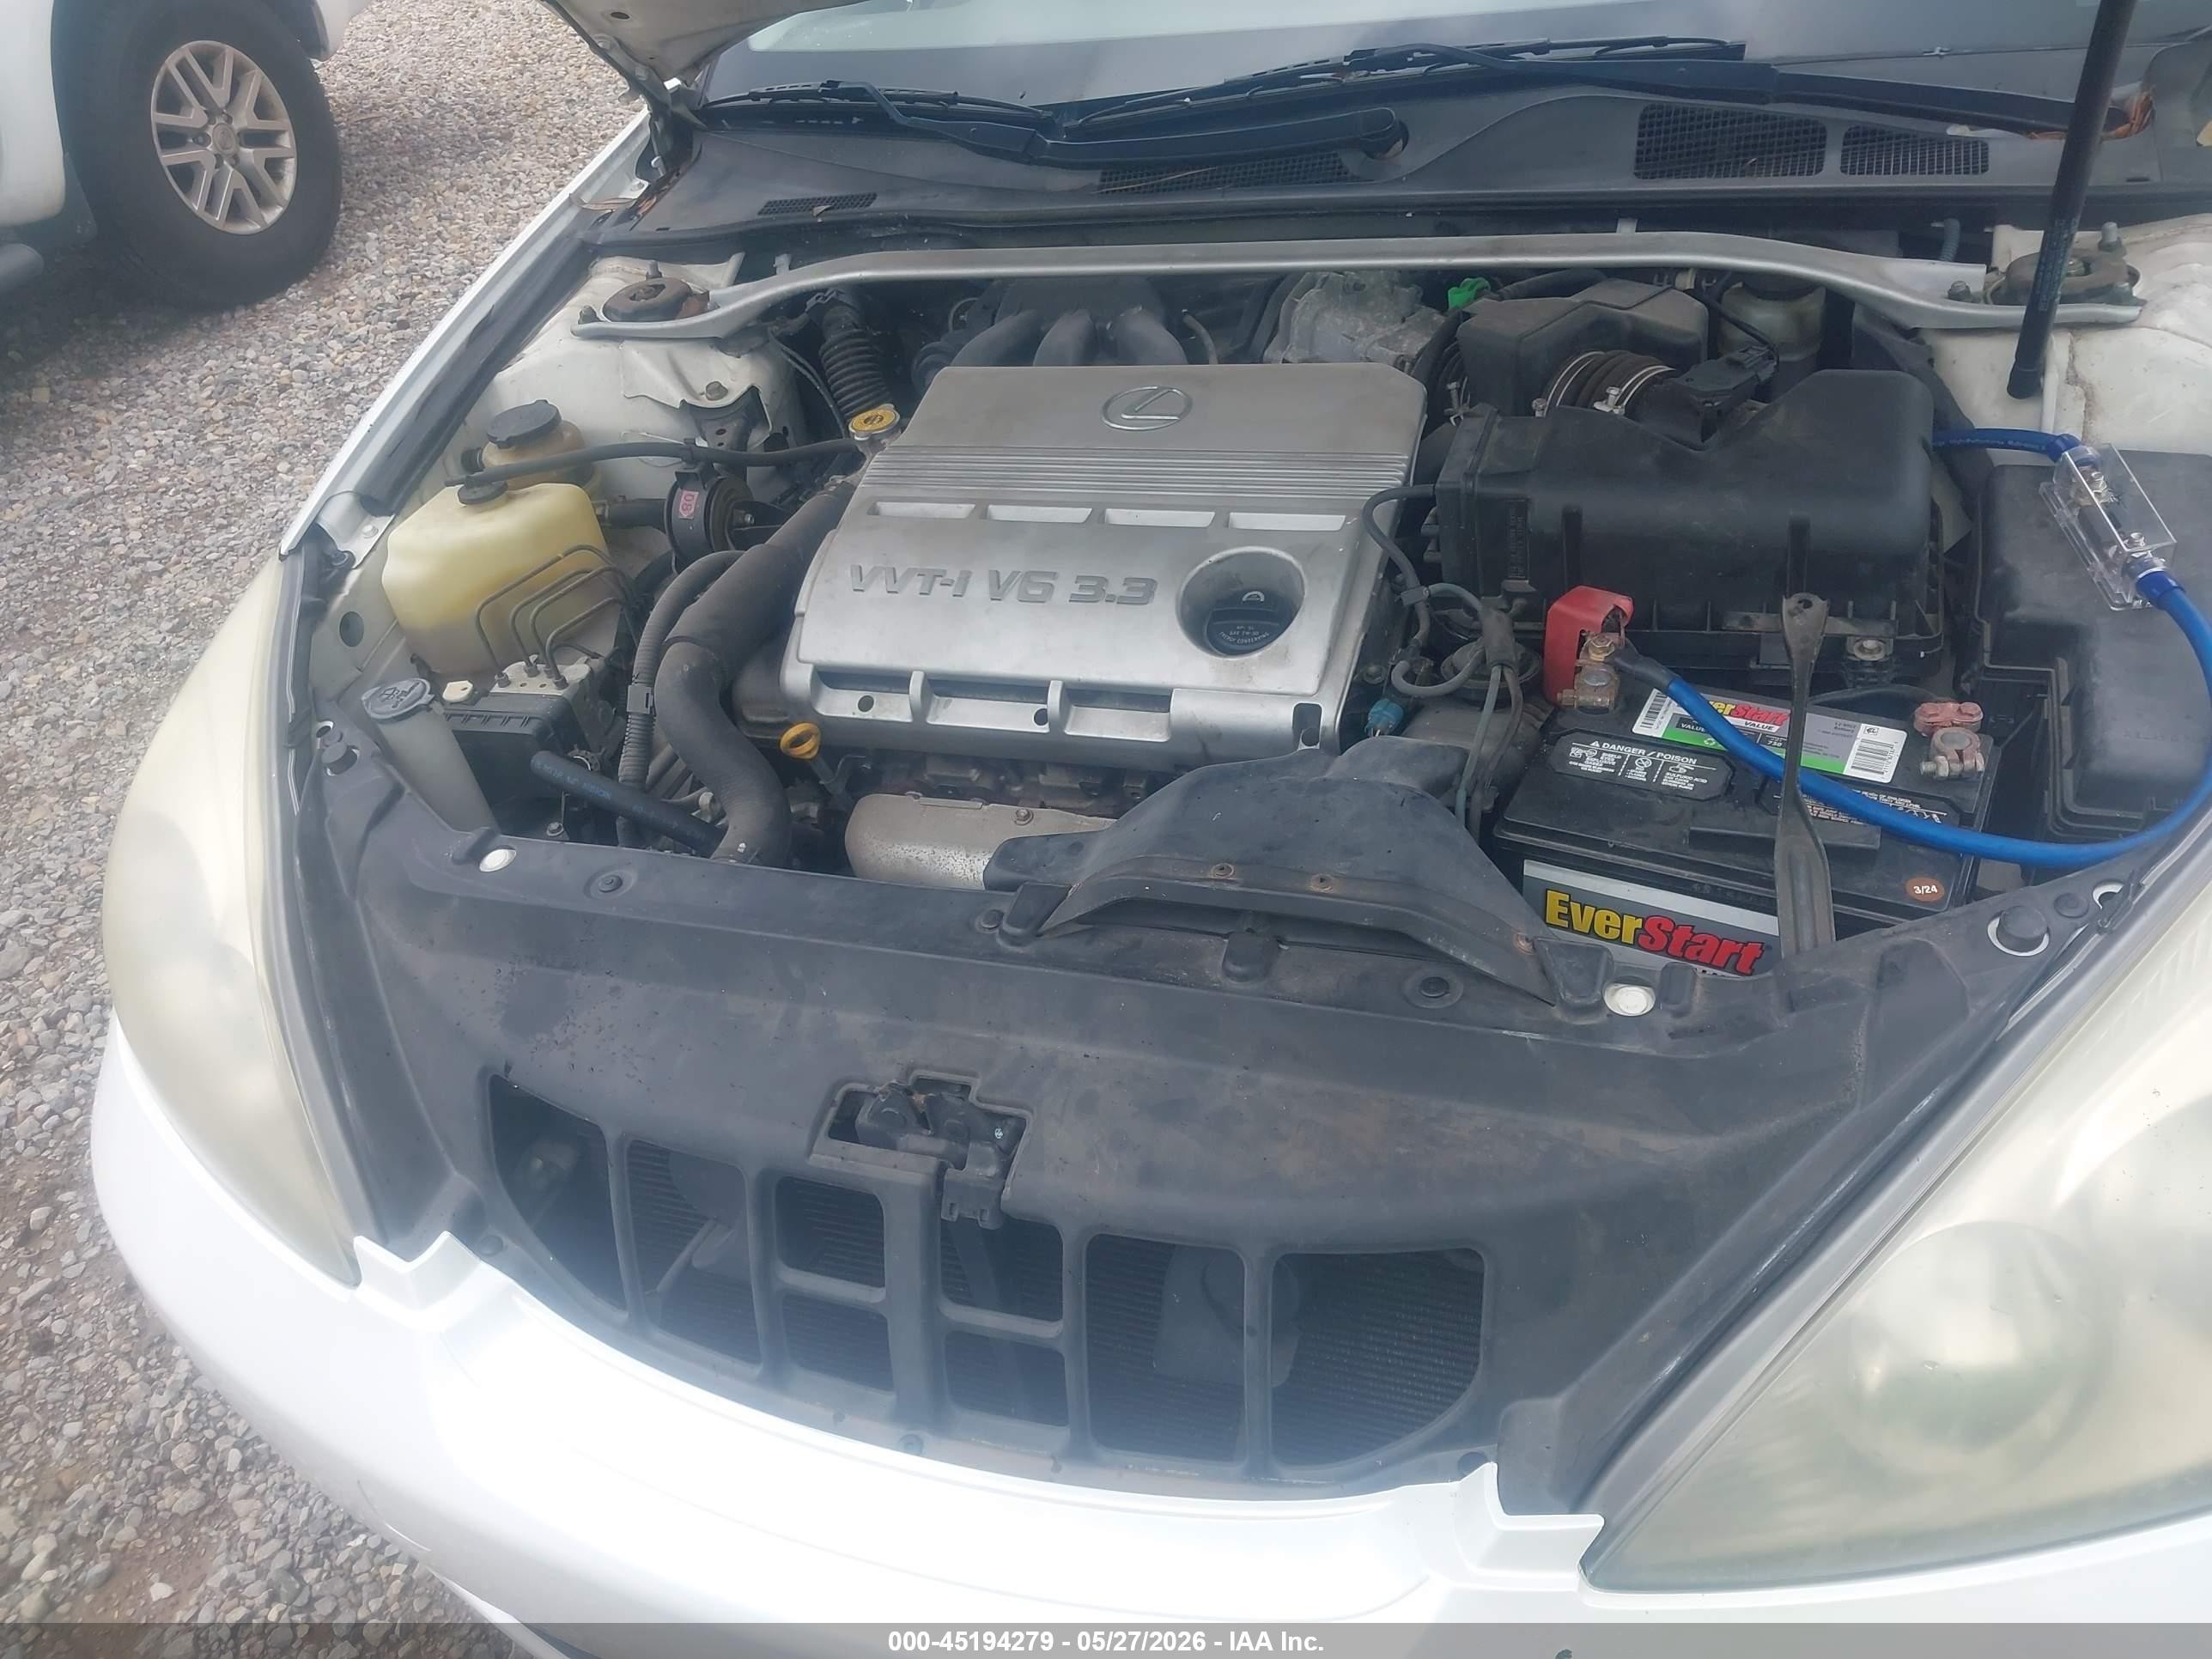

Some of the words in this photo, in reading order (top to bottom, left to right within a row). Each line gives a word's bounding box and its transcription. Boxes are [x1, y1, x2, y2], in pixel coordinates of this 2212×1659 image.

[988, 569, 1059, 603] V6
[1068, 574, 1159, 605] 3.3
[1744, 720, 1776, 732] VALUE
[1601, 742, 1647, 757] DANGER
[1656, 750, 1698, 765] POISON
[1913, 884, 1938, 896] 3/24
[1545, 888, 1765, 975] EverStart
